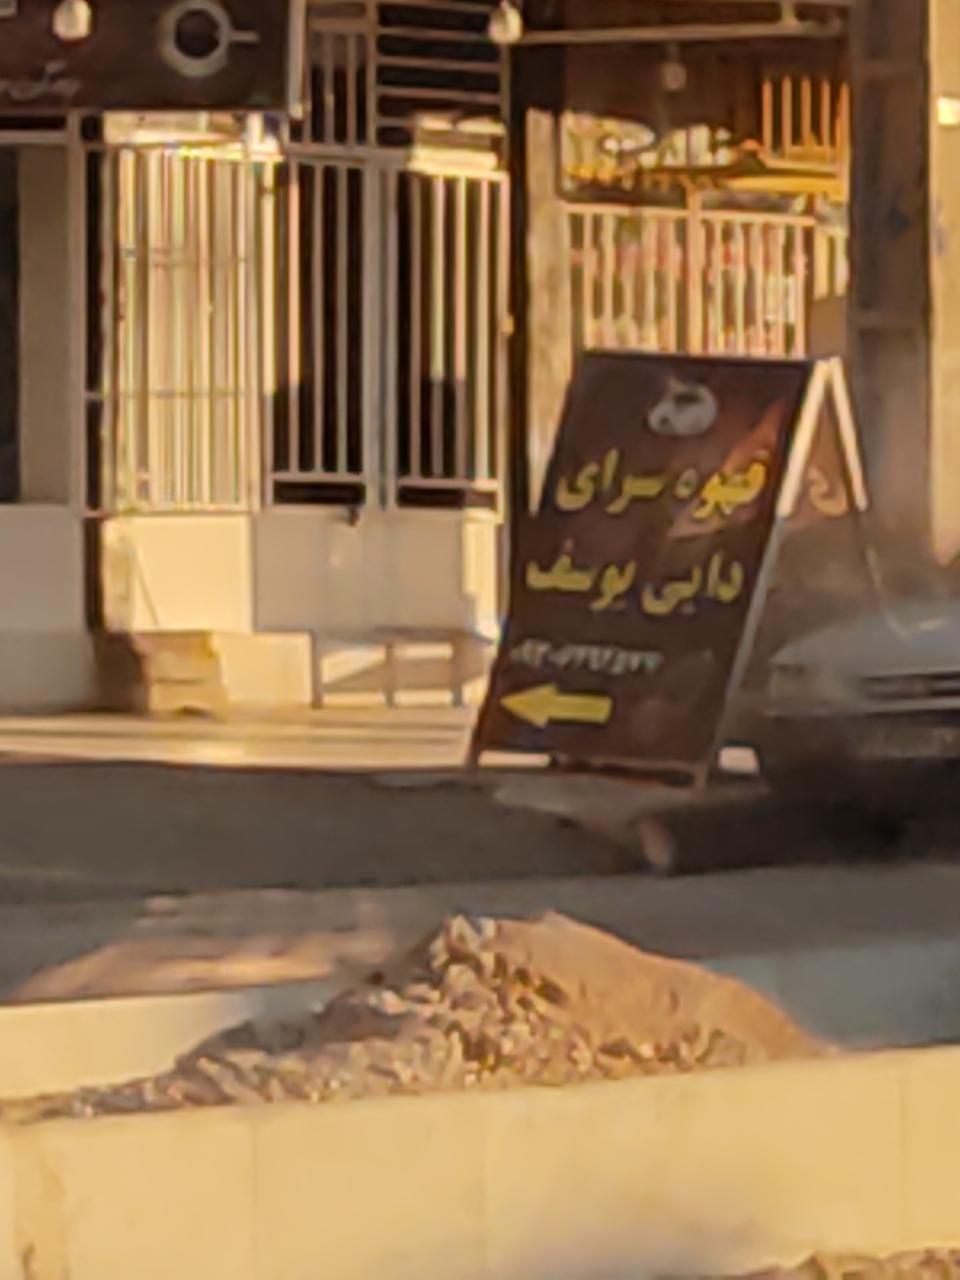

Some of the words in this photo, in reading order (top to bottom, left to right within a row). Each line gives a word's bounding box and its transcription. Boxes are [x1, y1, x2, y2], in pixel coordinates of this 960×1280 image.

[555, 448, 667, 515] سرای
[524, 538, 638, 612] یوسف
[641, 550, 745, 616] دایی
